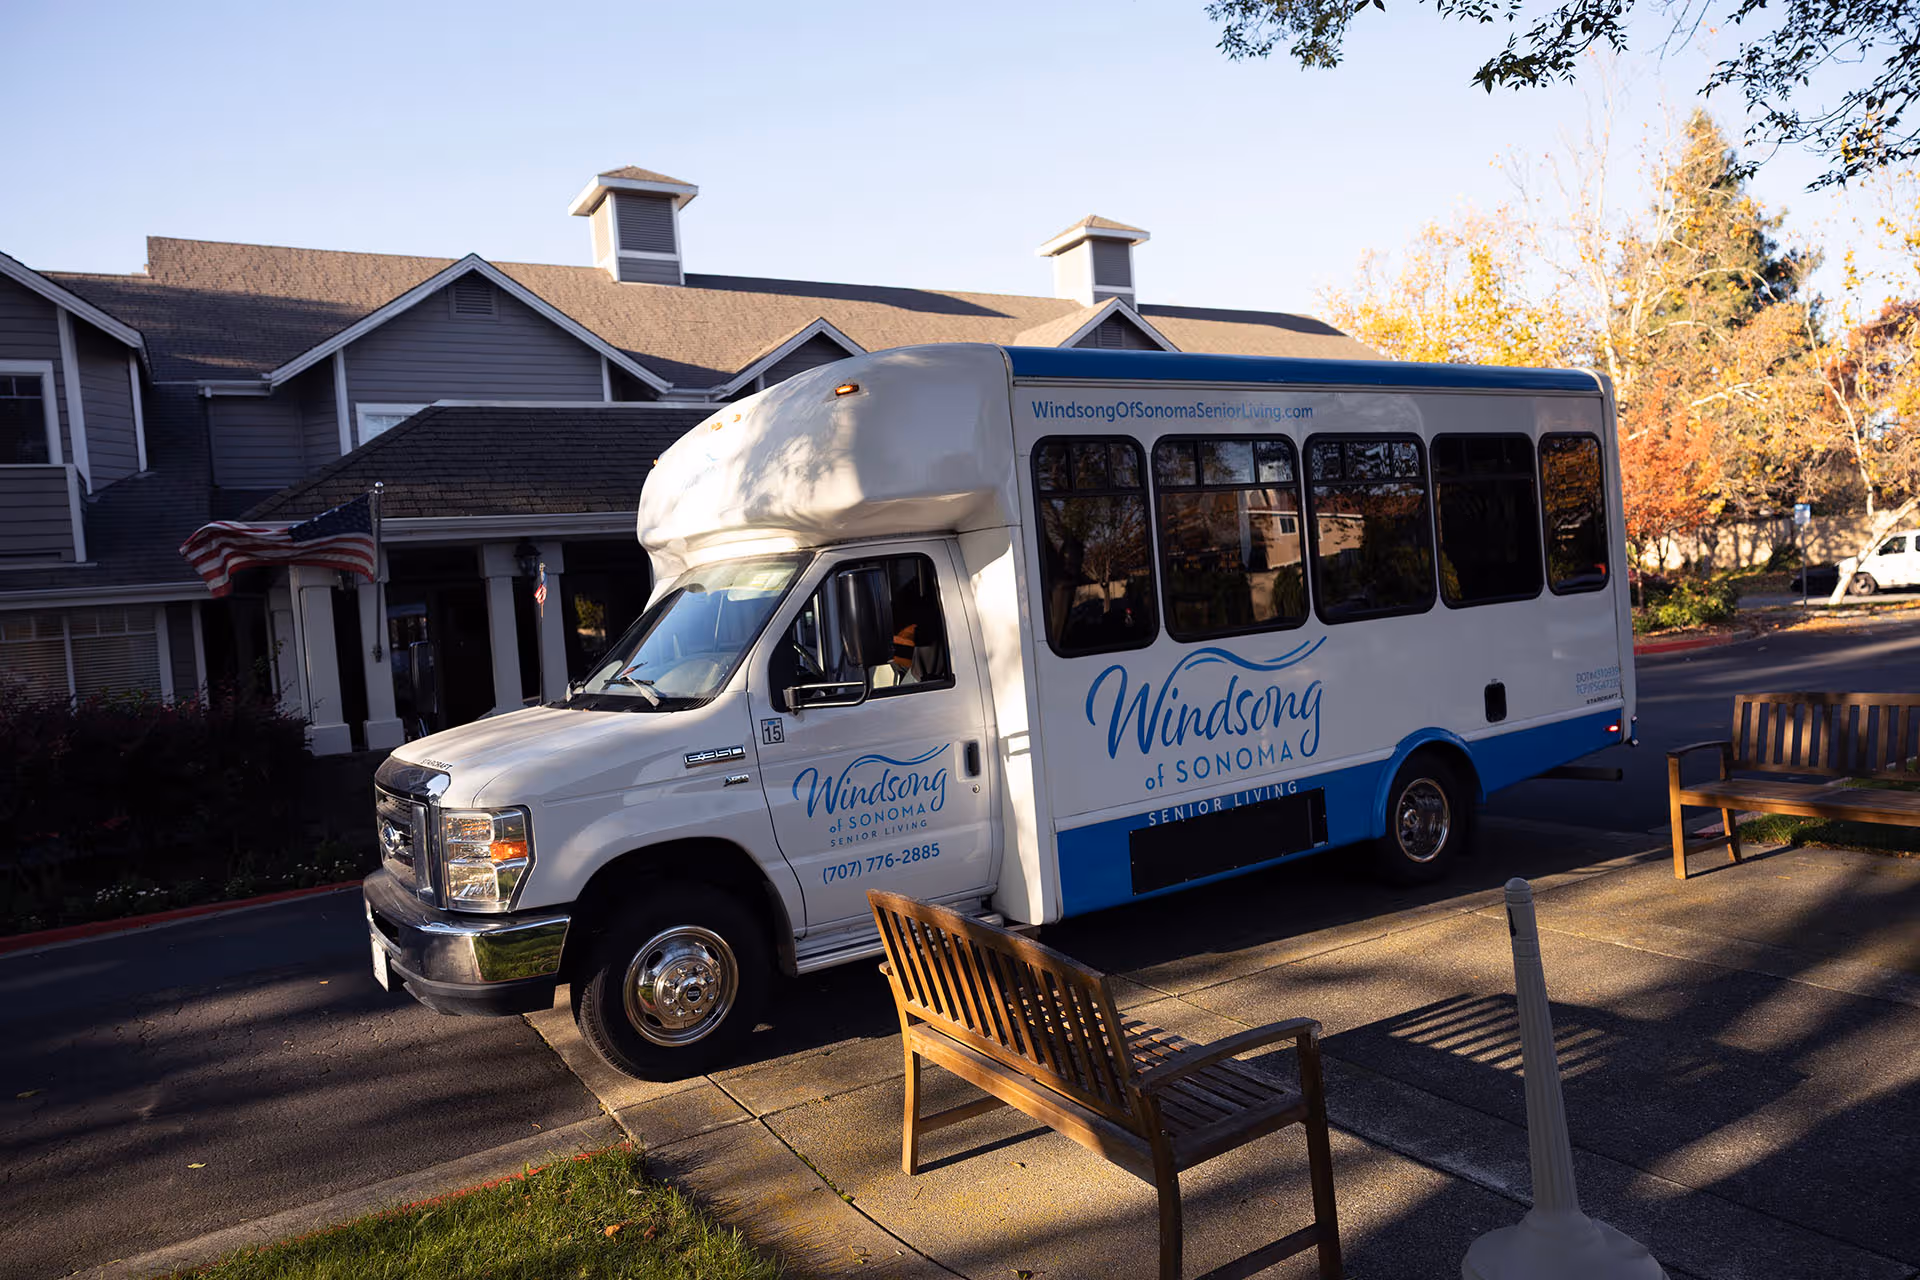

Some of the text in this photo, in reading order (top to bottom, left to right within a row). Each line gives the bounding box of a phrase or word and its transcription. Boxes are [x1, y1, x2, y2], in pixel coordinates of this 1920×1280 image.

[1032, 401, 1313, 422] WindsongOfSonomaSeniorLiving.com
[1086, 647, 1323, 759] Windsong
[765, 725, 781, 742] 15
[420, 758, 453, 770] STARCRAFT
[1145, 740, 1293, 790] of SONOMA
[792, 755, 947, 818] Windsong
[1149, 781, 1298, 826] SENIOR LIVING
[829, 803, 926, 834] of SONOMA
[830, 819, 927, 847] SENIOR LIVING
[823, 843, 940, 884] (707) 776-2885
